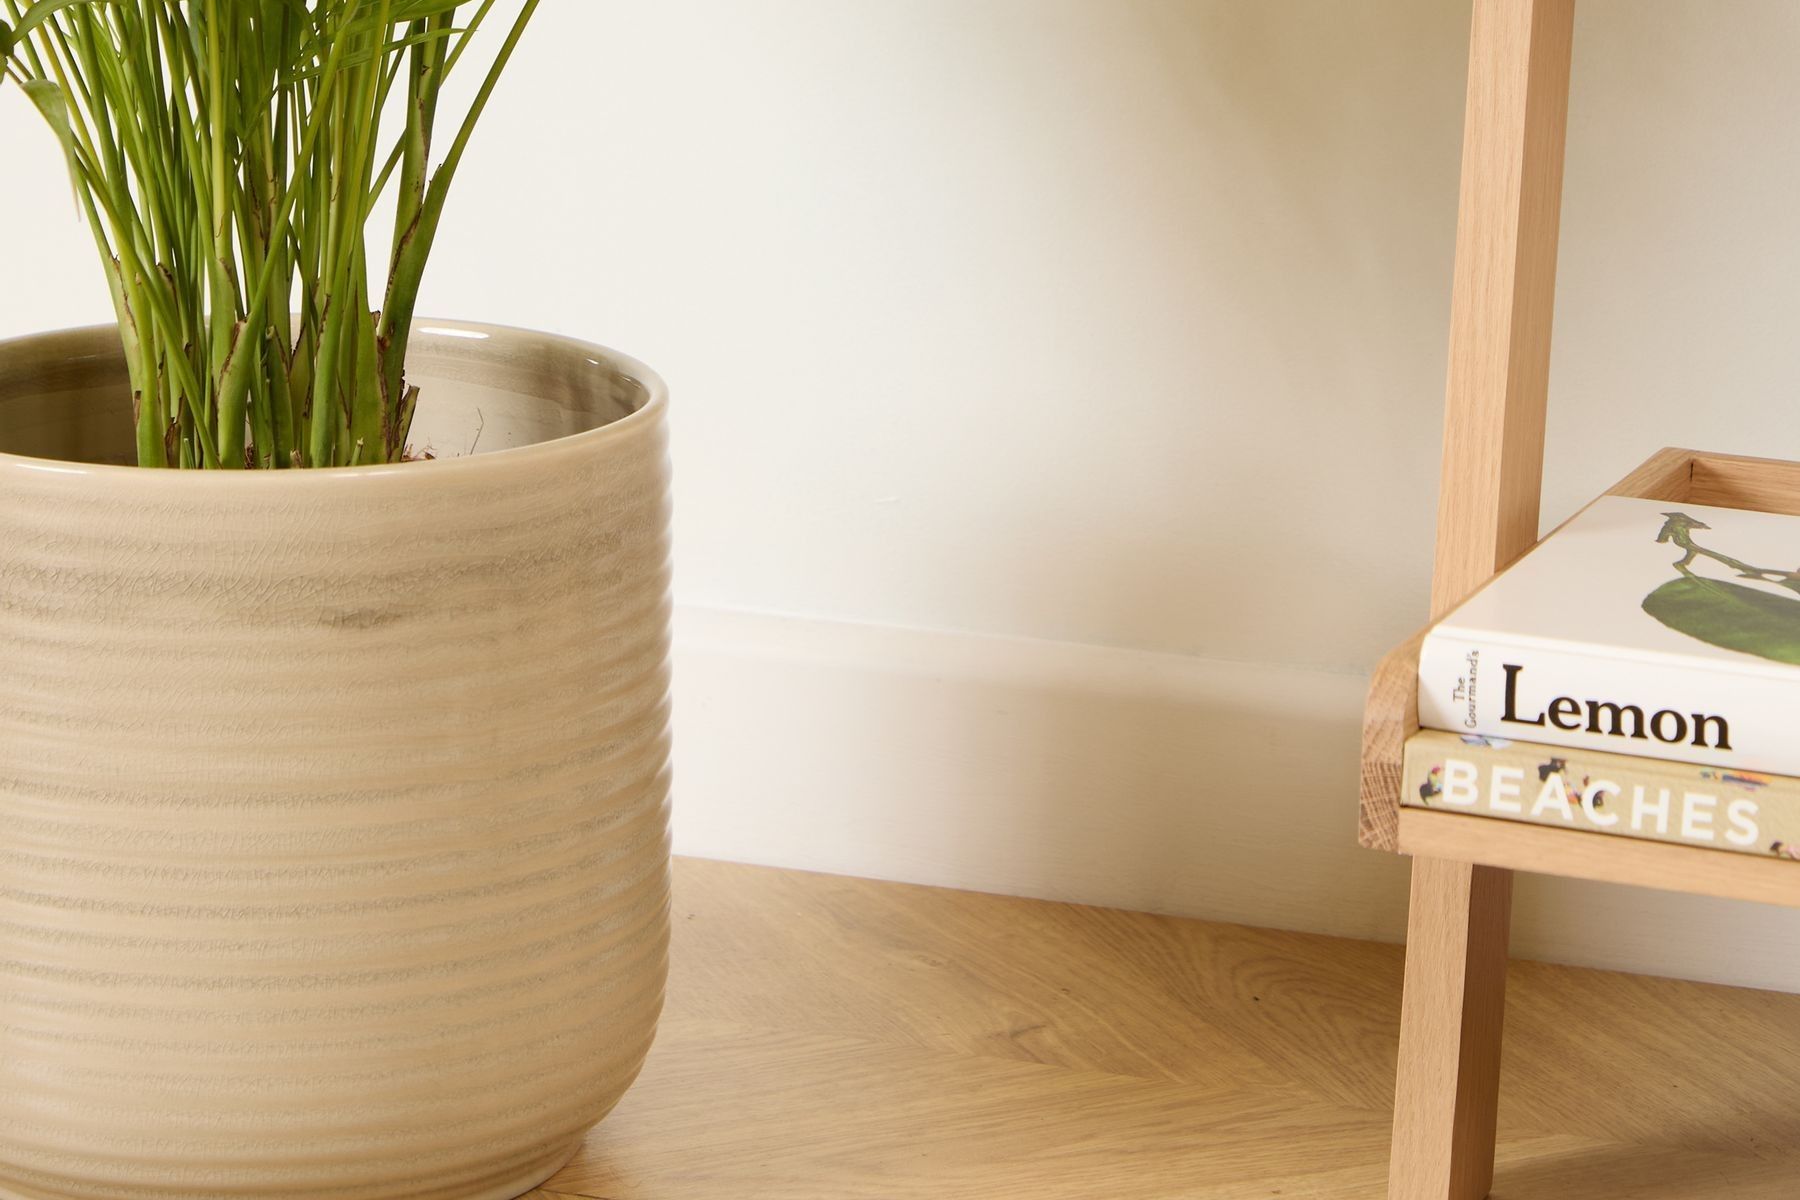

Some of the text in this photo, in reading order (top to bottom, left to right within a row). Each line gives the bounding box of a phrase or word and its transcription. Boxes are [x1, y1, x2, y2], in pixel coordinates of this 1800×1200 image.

[1453, 677, 1465, 702] The
[1501, 663, 1732, 750] Lemon
[1442, 759, 1760, 847] BEACHES
